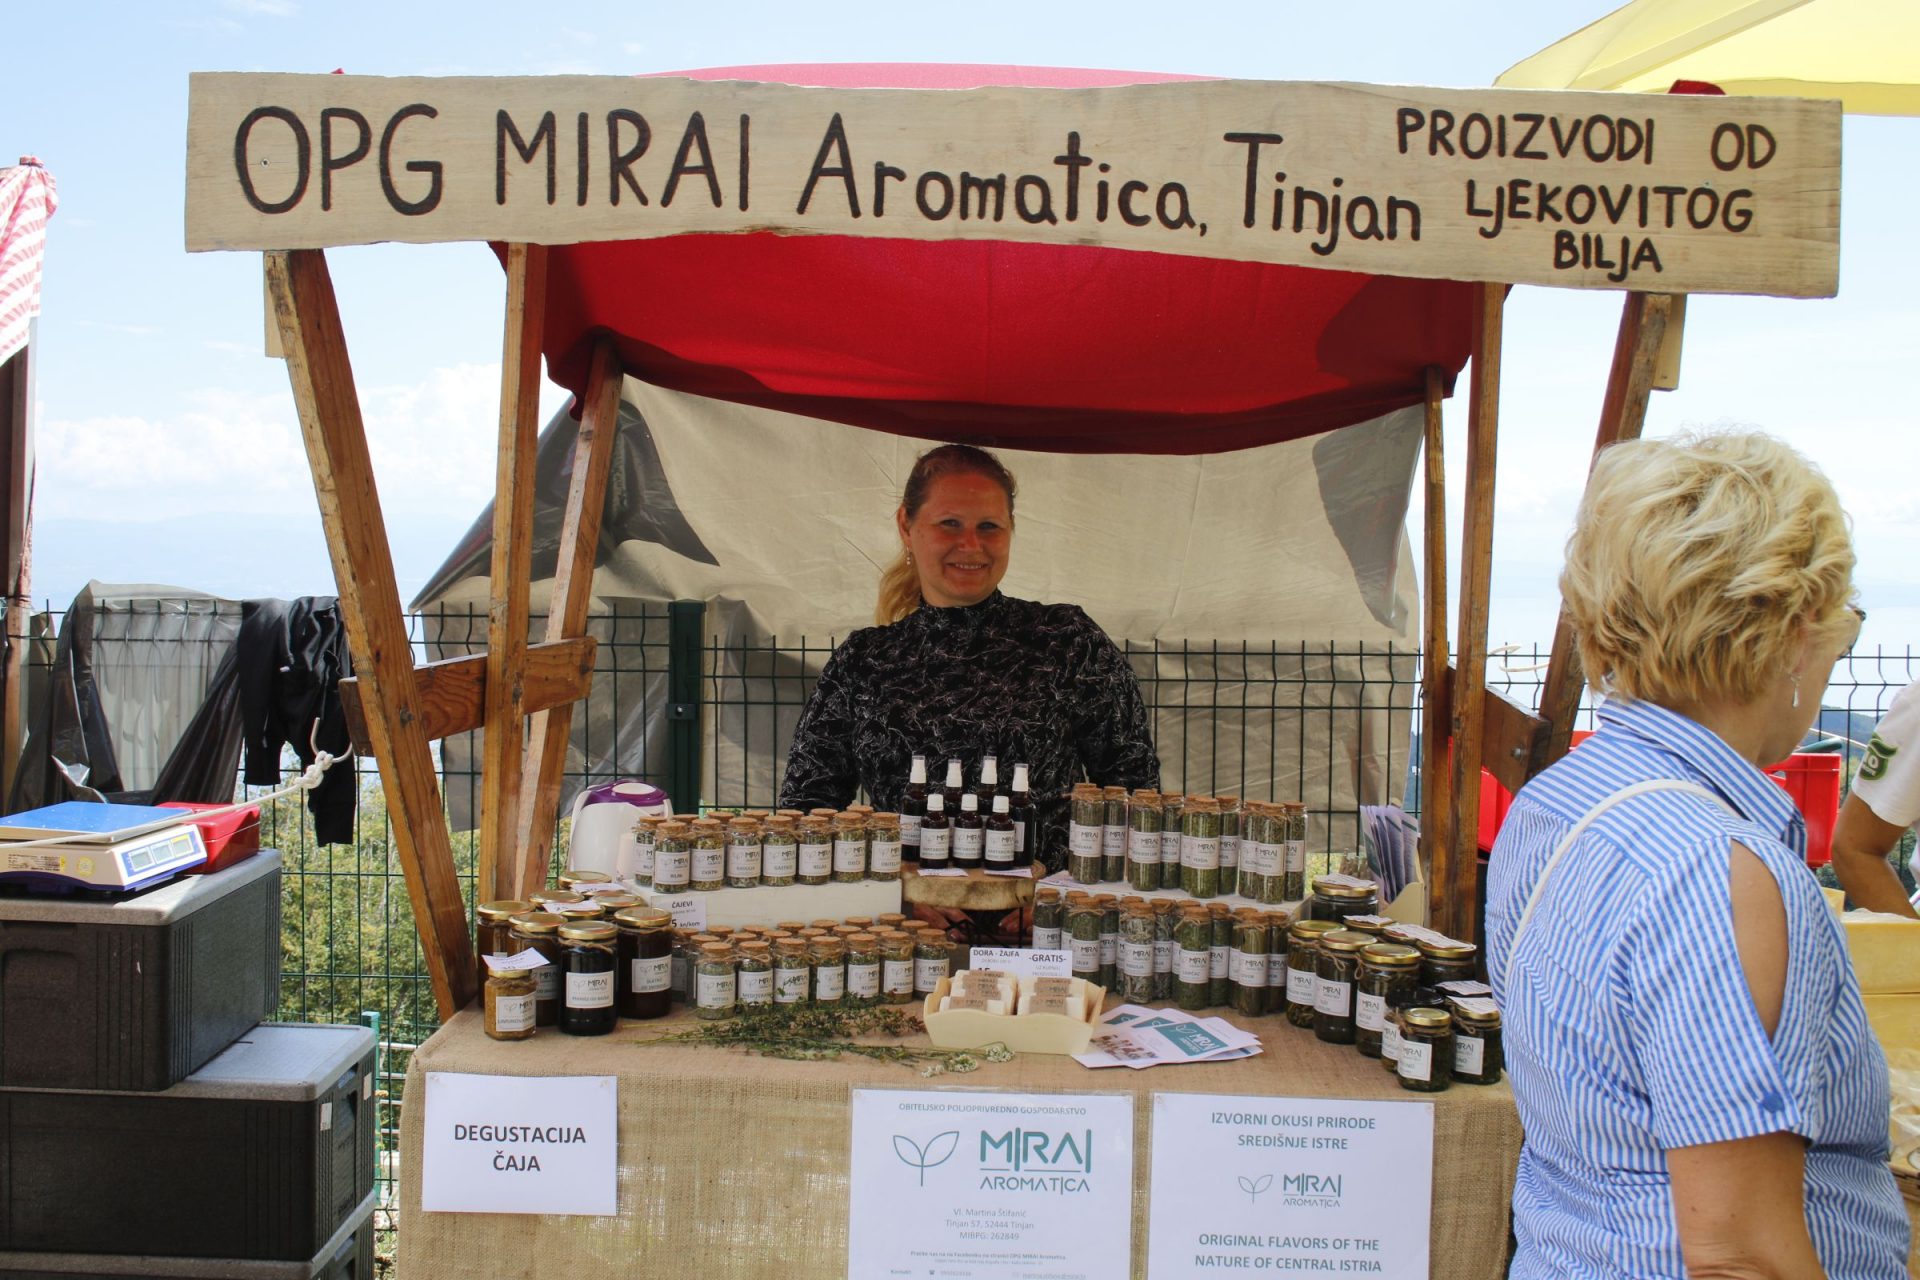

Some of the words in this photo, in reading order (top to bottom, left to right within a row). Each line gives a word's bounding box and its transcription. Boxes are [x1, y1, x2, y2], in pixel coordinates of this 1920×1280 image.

[1396, 107, 1655, 165] PROIZVODI
[1710, 122, 1777, 172] OD
[234, 103, 443, 217] OPG
[496, 107, 751, 213] MIRAI
[797, 112, 1208, 237] Aromatica,
[1223, 131, 1422, 256] Tinjan
[1465, 178, 1753, 239] LJEKOVITOG
[1553, 229, 1664, 283] BILJA
[671, 899, 694, 909] ČAJEVI
[973, 949, 994, 957] DORA
[898, 1102, 946, 1113] OBITELJSKO
[946, 1103, 1019, 1115] POLJOPRIVREDNO
[1020, 1106, 1087, 1116] GOSPODARSTVO
[1211, 1112, 1268, 1126] IZVORNI
[1271, 1114, 1313, 1128] OKUSI
[1316, 1116, 1376, 1130] PRIRODE
[454, 1123, 586, 1144] DEGUSTACIJA
[1237, 1133, 1308, 1149] SREDIŠNJE
[1312, 1137, 1348, 1150] ISTRE
[979, 1126, 1093, 1174] MIRAI
[492, 1149, 541, 1172] ČAJA
[979, 1176, 1091, 1195] AROMATICA
[1283, 1172, 1342, 1197] MIRAI
[1283, 1197, 1341, 1209] AROMATICA
[965, 1208, 996, 1218] Martina
[945, 1218, 969, 1230] Tinjan
[1010, 1220, 1034, 1231] Tinjan
[1198, 1233, 1265, 1248] ORIGINAL
[1268, 1235, 1329, 1250] FLAVORS
[1332, 1238, 1350, 1250] OF
[1354, 1239, 1380, 1251] THE
[1195, 1255, 1250, 1269] NATURE
[1254, 1257, 1272, 1269] OF
[1276, 1257, 1336, 1271] CENTRAL
[1339, 1259, 1382, 1272] ISTRIA
